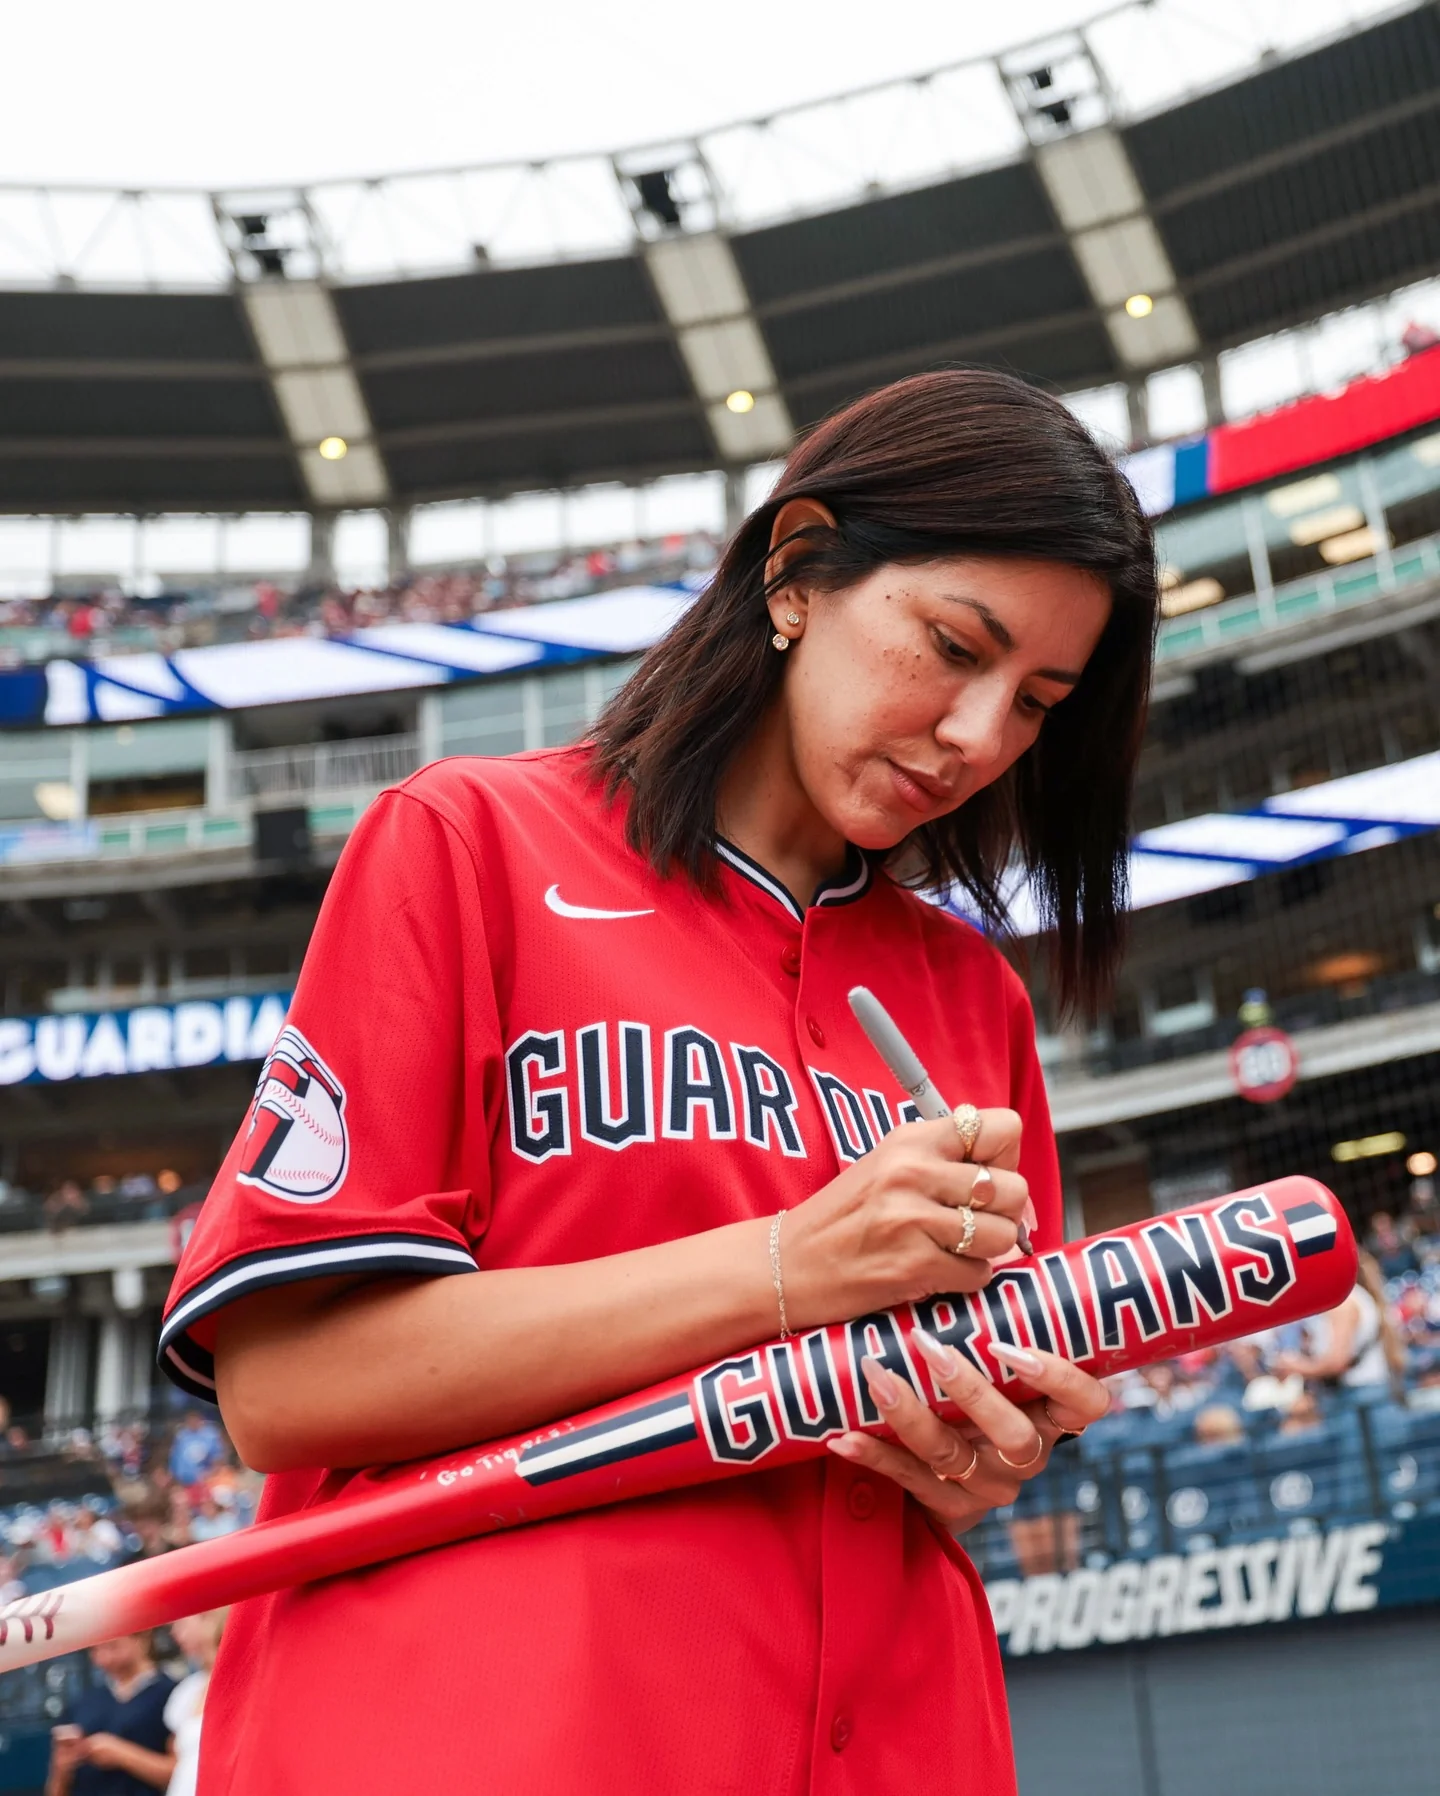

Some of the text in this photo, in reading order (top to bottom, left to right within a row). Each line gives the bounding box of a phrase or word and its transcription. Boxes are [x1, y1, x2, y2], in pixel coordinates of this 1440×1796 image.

[505, 1021, 926, 1164] GUARDI
[693, 1192, 1297, 1465] GUARDIANS
[437, 1465, 474, 1487] Go
[985, 1521, 1388, 1657] PROGRESSIVE
